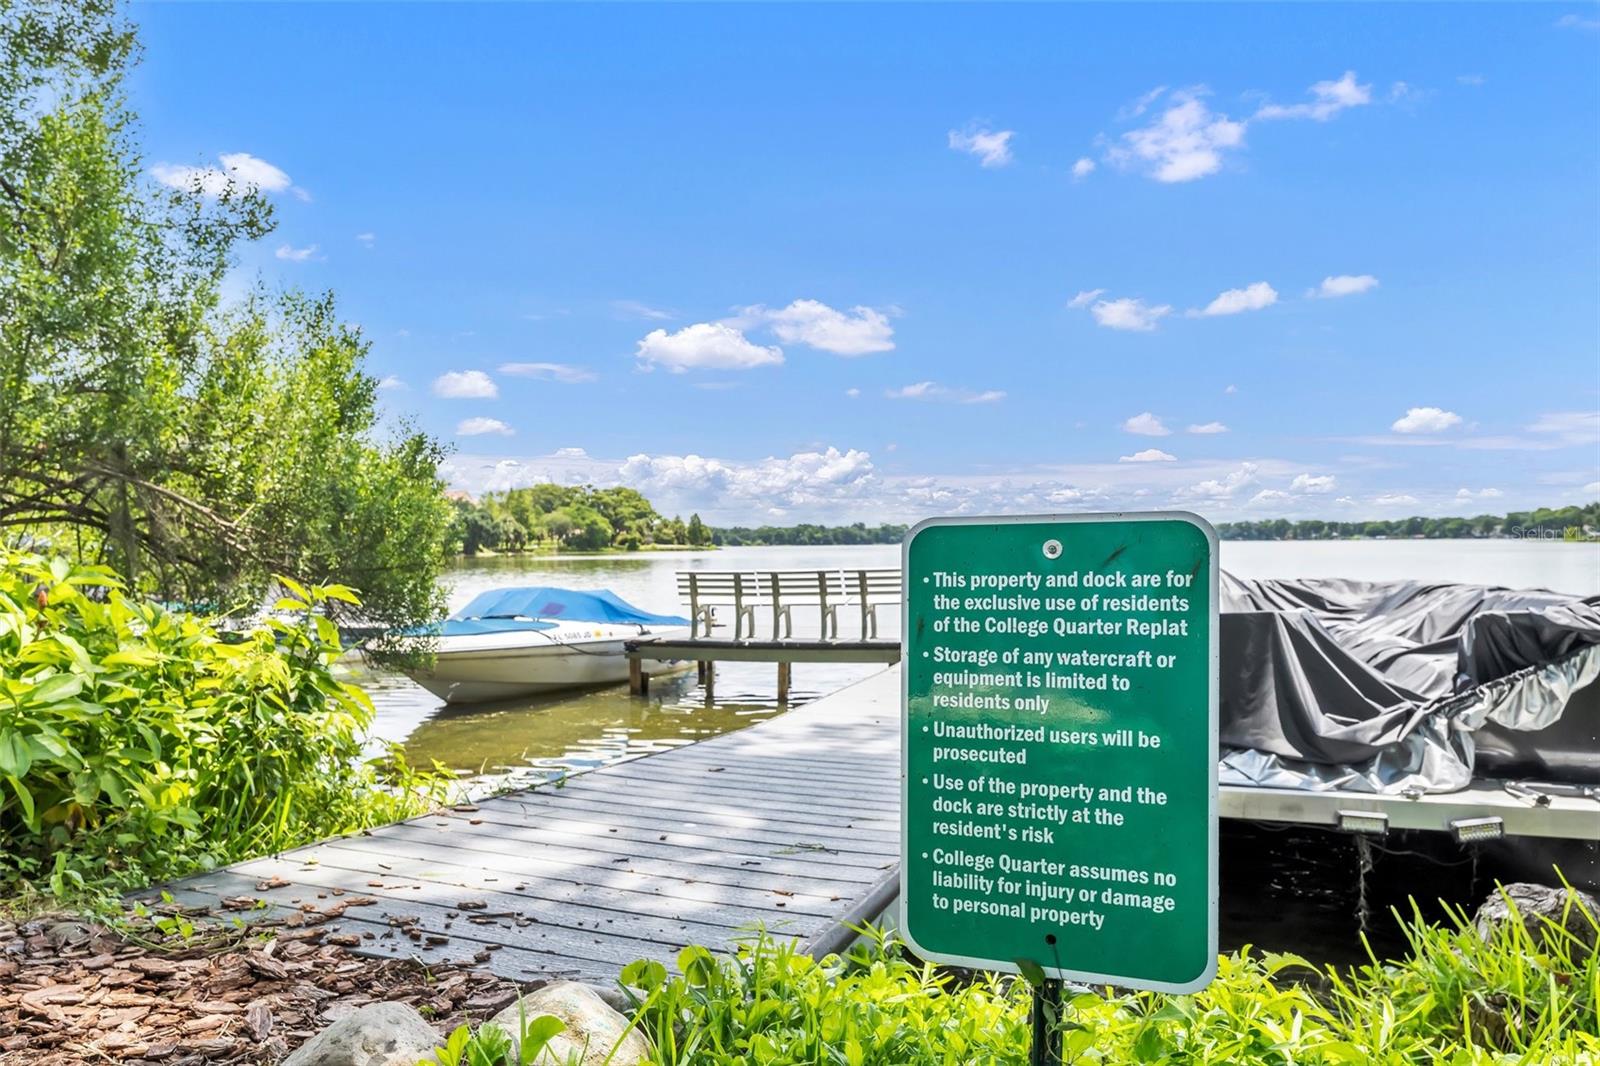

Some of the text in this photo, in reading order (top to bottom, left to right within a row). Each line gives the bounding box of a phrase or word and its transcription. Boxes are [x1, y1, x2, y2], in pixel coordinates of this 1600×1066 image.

[933, 570, 1192, 590] This property and dock are for
[934, 594, 1189, 611] the exclusive use of residents
[934, 617, 1187, 639] of the College Quarter Replat
[934, 647, 1176, 668] Storage of any watercraft or
[933, 670, 1129, 690] equipment is limited to
[933, 693, 1049, 715] residents only
[934, 721, 1160, 748] Unauthorized users will be
[934, 748, 1026, 764] prosecuted
[934, 774, 1167, 805] Use of the property and the
[933, 797, 1123, 825] dock are strictly at the
[934, 821, 1053, 843] resident's risk
[933, 849, 1176, 886] College Quarter assumes no
[934, 871, 1175, 913] liability for injury or damage
[933, 894, 1104, 930] to personal property
